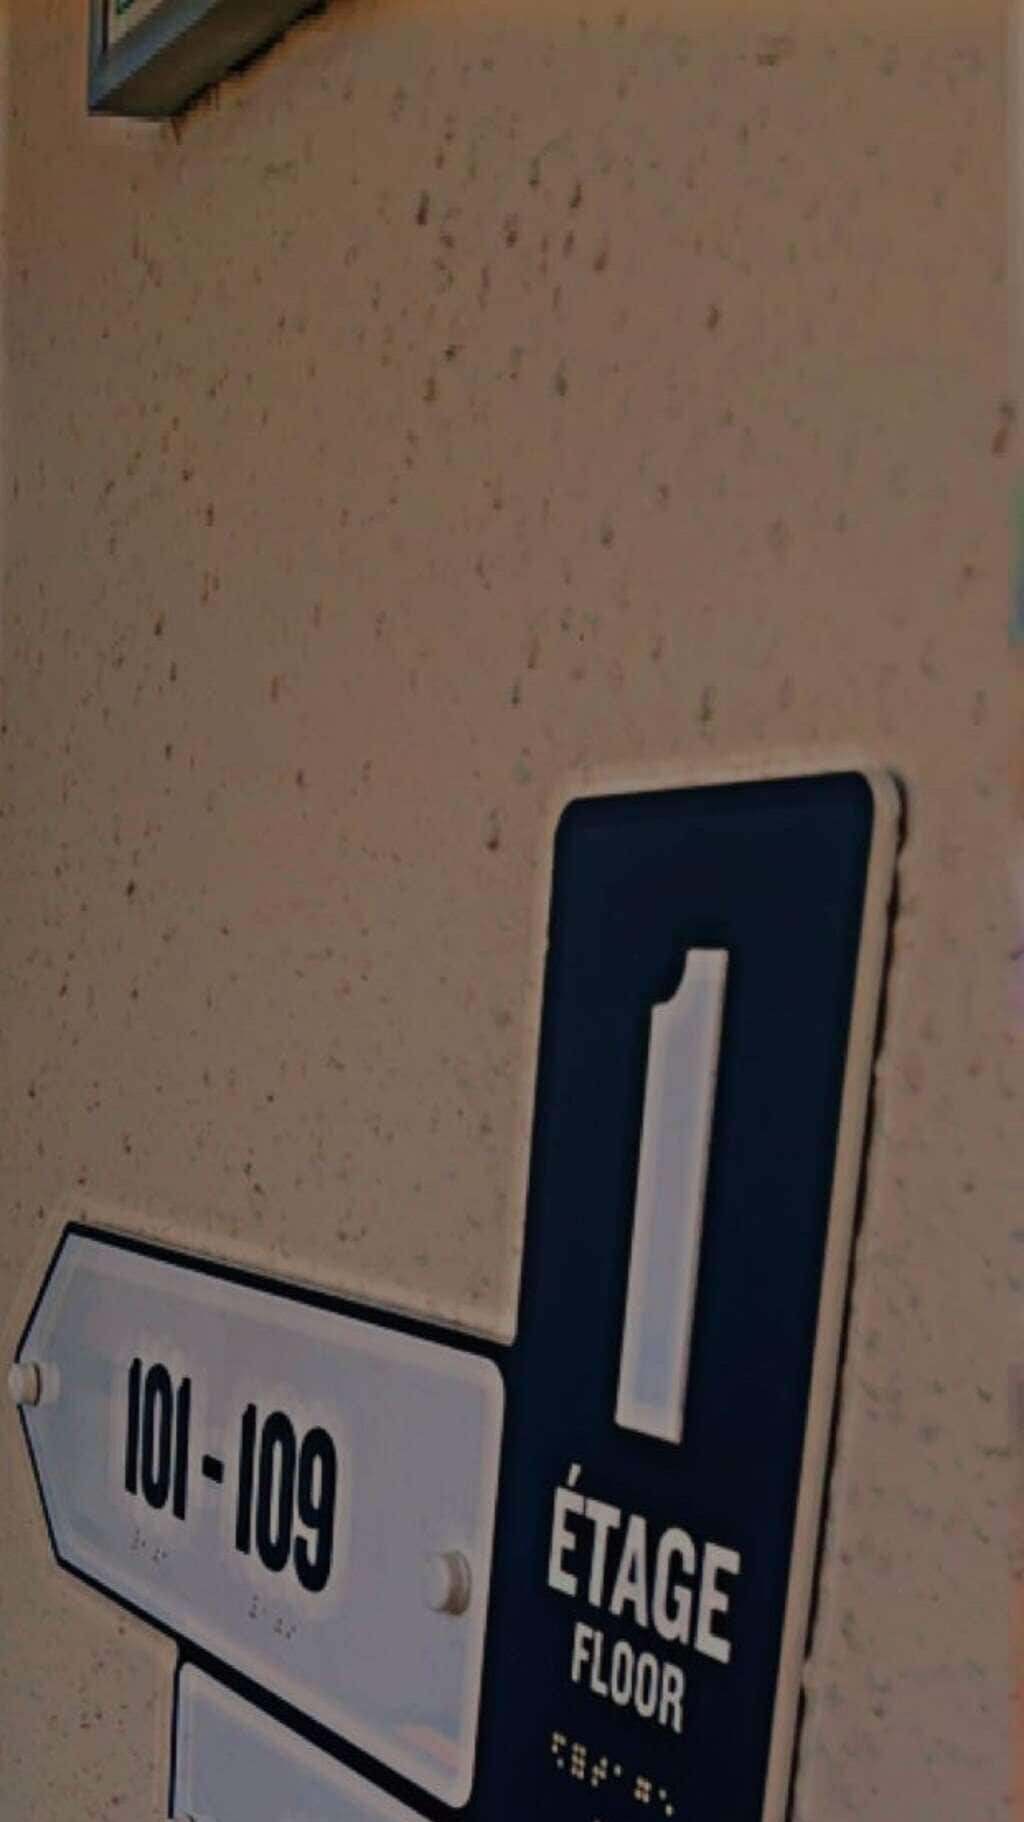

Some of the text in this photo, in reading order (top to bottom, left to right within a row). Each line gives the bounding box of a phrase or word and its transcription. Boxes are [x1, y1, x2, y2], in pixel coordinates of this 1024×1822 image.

[613, 947, 730, 1447] 1
[547, 1462, 742, 1664] ÉTAGE
[571, 1620, 687, 1734] FLOOR
